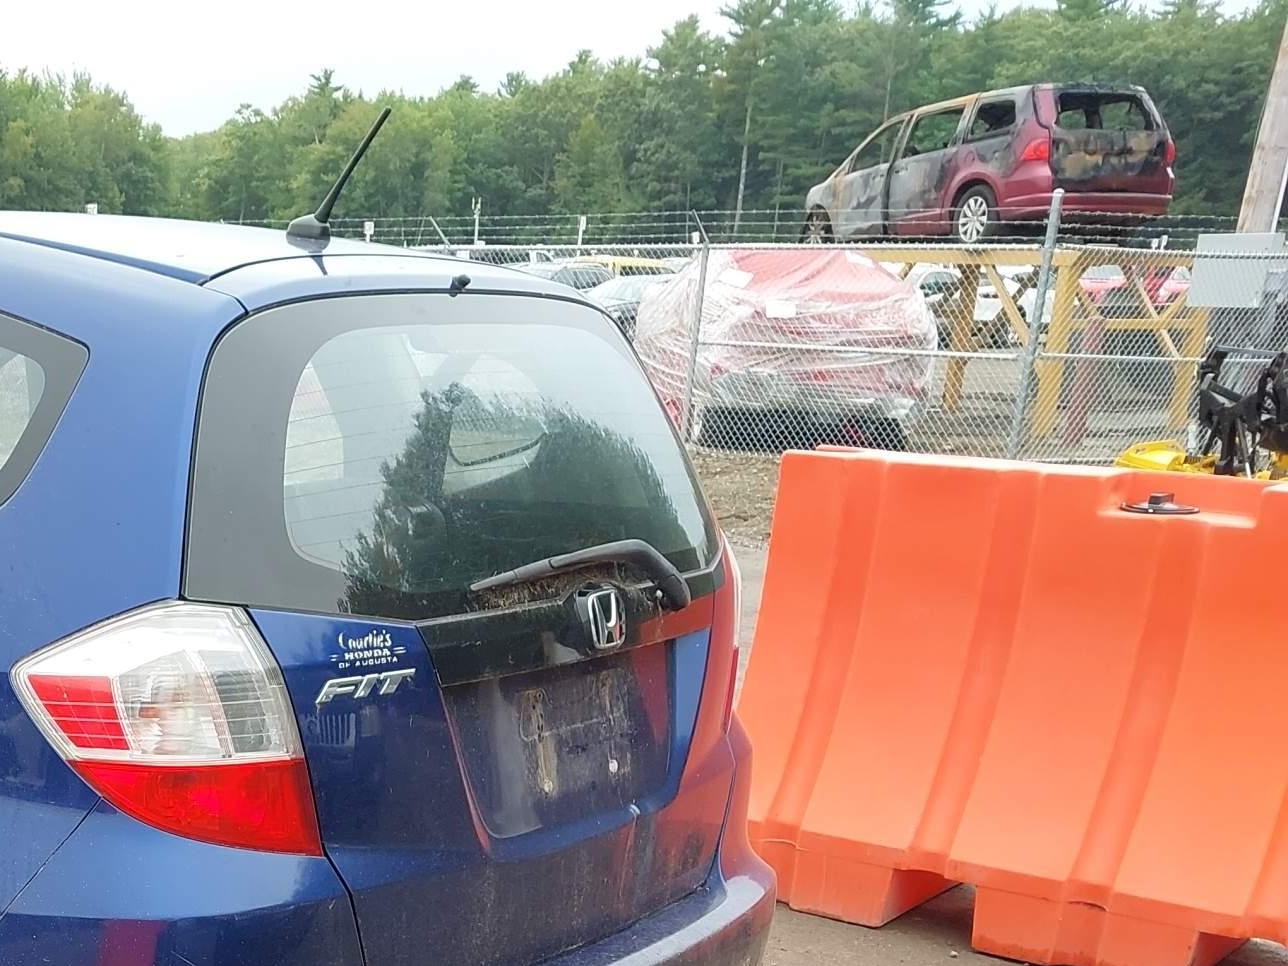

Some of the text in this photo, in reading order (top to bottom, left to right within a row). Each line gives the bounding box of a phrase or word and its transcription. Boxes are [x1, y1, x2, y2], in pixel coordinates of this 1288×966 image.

[343, 648, 392, 661] HONDA
[355, 656, 398, 667] AUGUSTA
[315, 667, 416, 704] FIT
